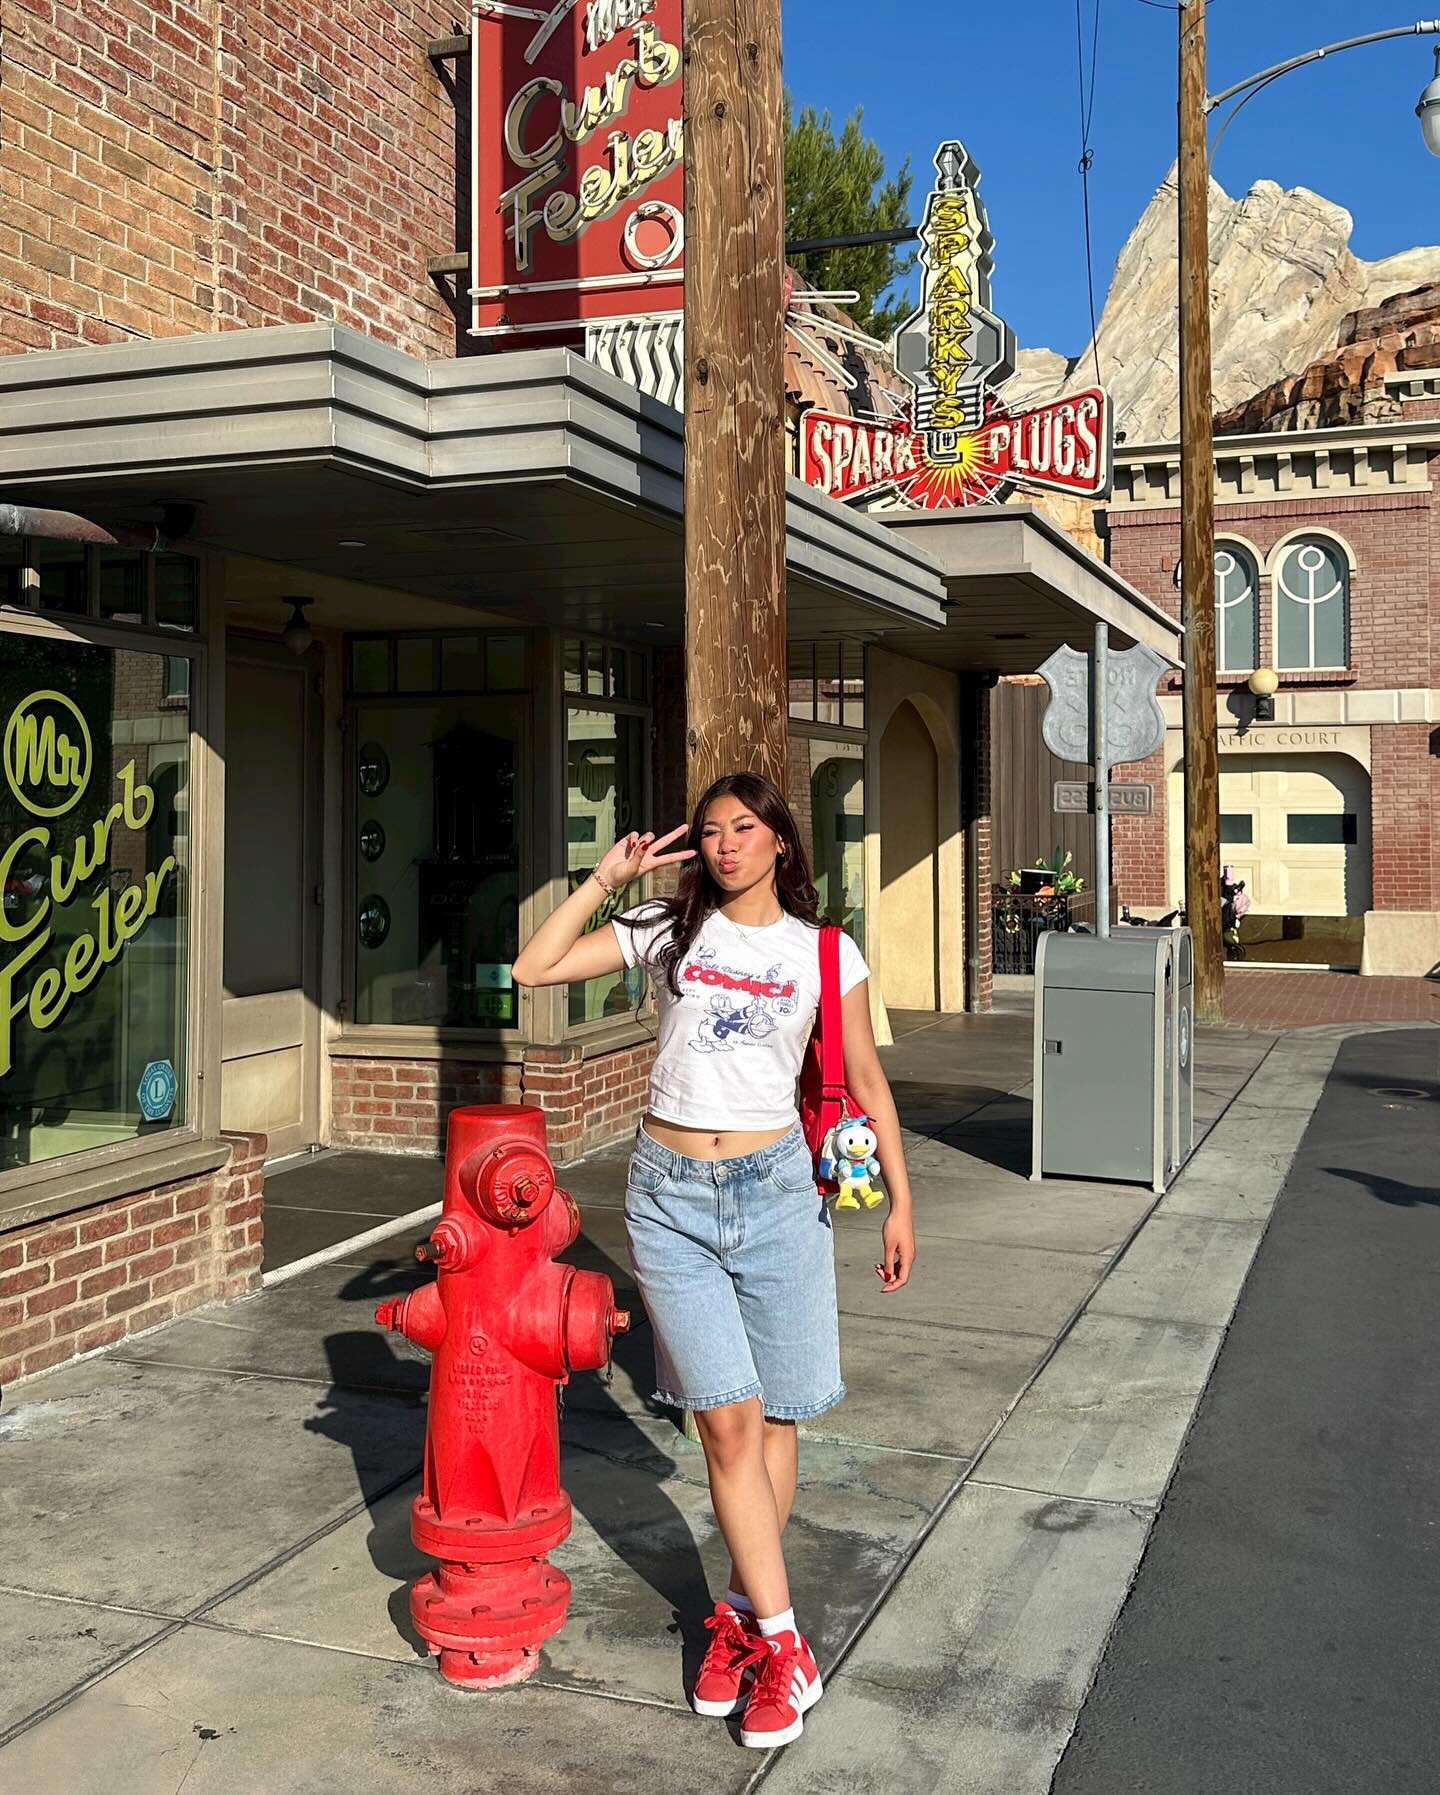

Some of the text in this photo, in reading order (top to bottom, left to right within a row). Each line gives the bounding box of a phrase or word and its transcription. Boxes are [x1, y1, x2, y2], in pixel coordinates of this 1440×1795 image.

[505, 21, 680, 169] Curb
[930, 197, 973, 428] SPARKYS
[811, 397, 1099, 495] SPARK PLUGS
[15, 714, 84, 786] Mr
[1218, 732, 1342, 746] AFFIC COURT
[0, 759, 155, 941] Curb
[0, 856, 175, 1077] Feeler
[684, 965, 796, 998] COMICS
[153, 1080, 164, 1099] L
